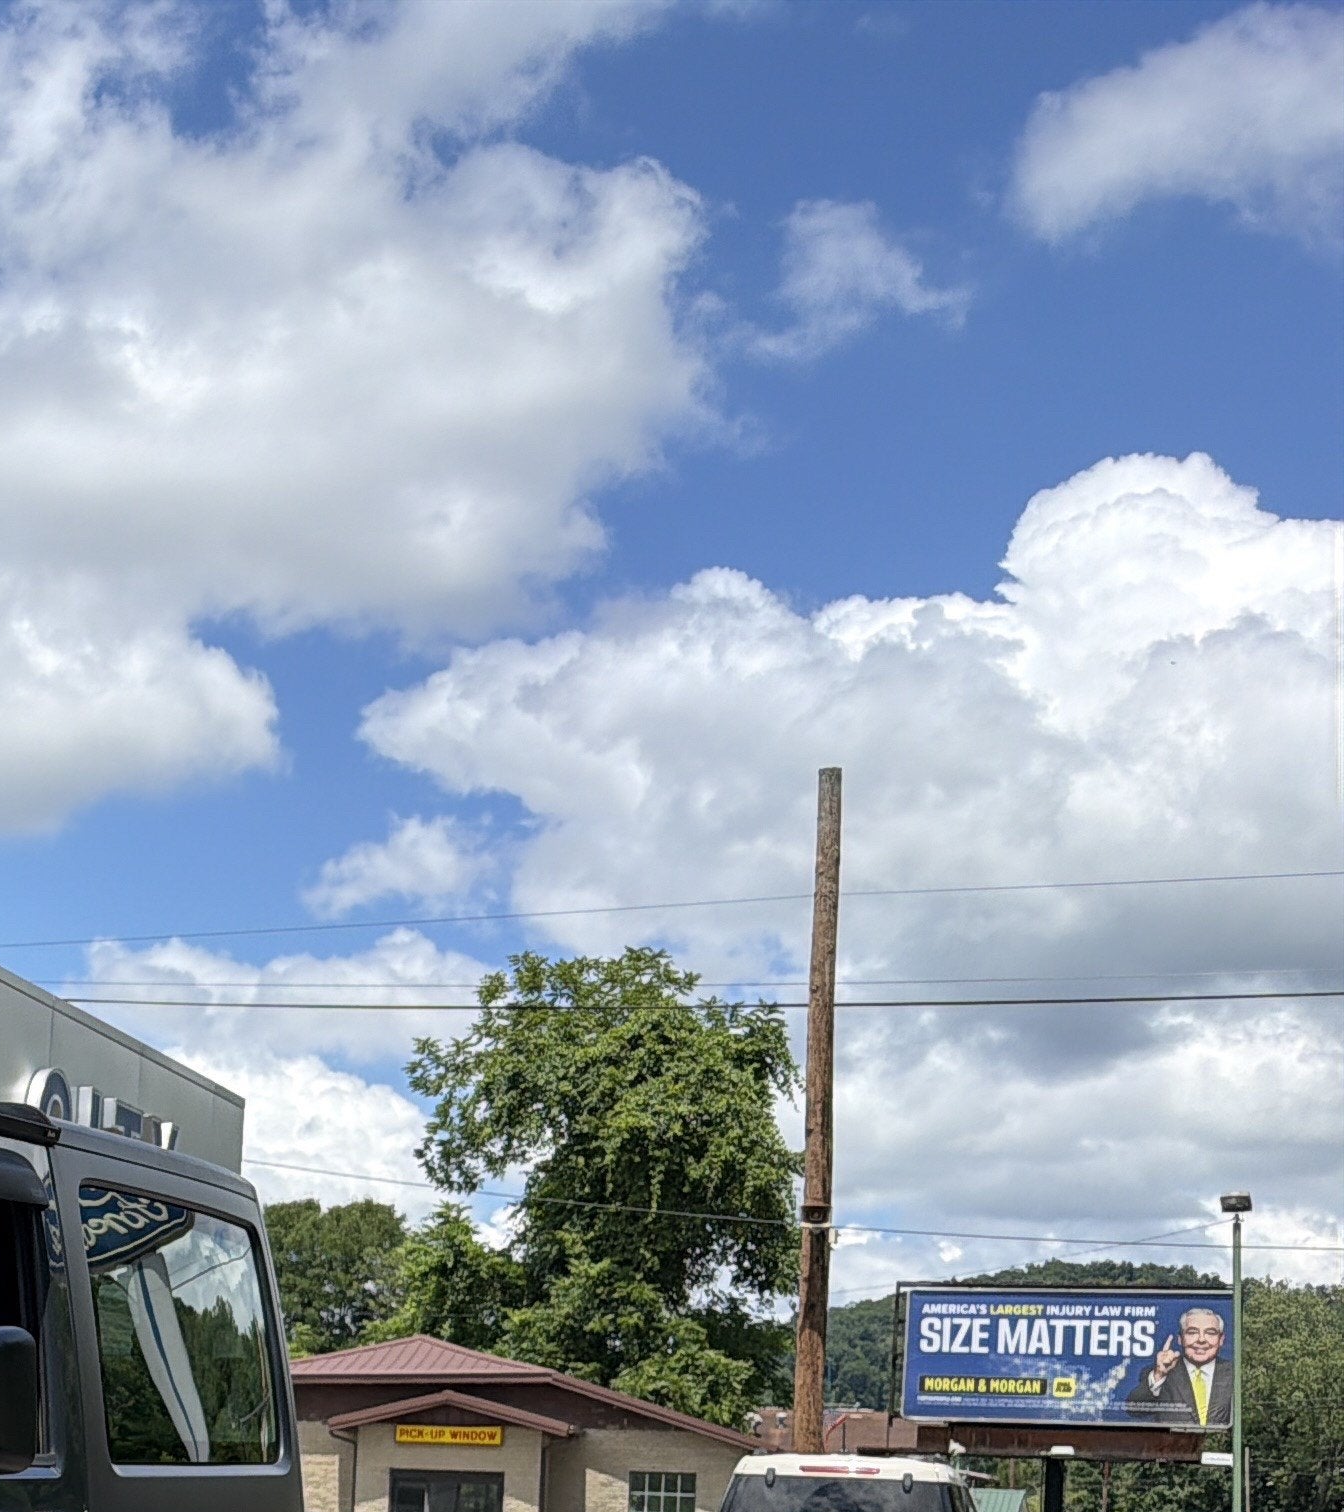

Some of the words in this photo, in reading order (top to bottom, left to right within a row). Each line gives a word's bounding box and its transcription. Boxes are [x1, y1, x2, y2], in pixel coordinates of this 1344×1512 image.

[922, 1304, 987, 1315] AMERICA'S
[990, 1304, 1044, 1316] LARGEST
[1046, 1305, 1091, 1316] INJURY
[1094, 1306, 1121, 1317] LAW
[1124, 1306, 1156, 1317] FIRM
[919, 1316, 991, 1354] SIZE
[997, 1317, 1155, 1357] MATTERS
[924, 1377, 975, 1392] MORGAN
[978, 1378, 987, 1392] &
[989, 1378, 1041, 1394] MORGAN
[399, 1428, 445, 1439] PICK-UP
[449, 1430, 497, 1441] WINDOW
